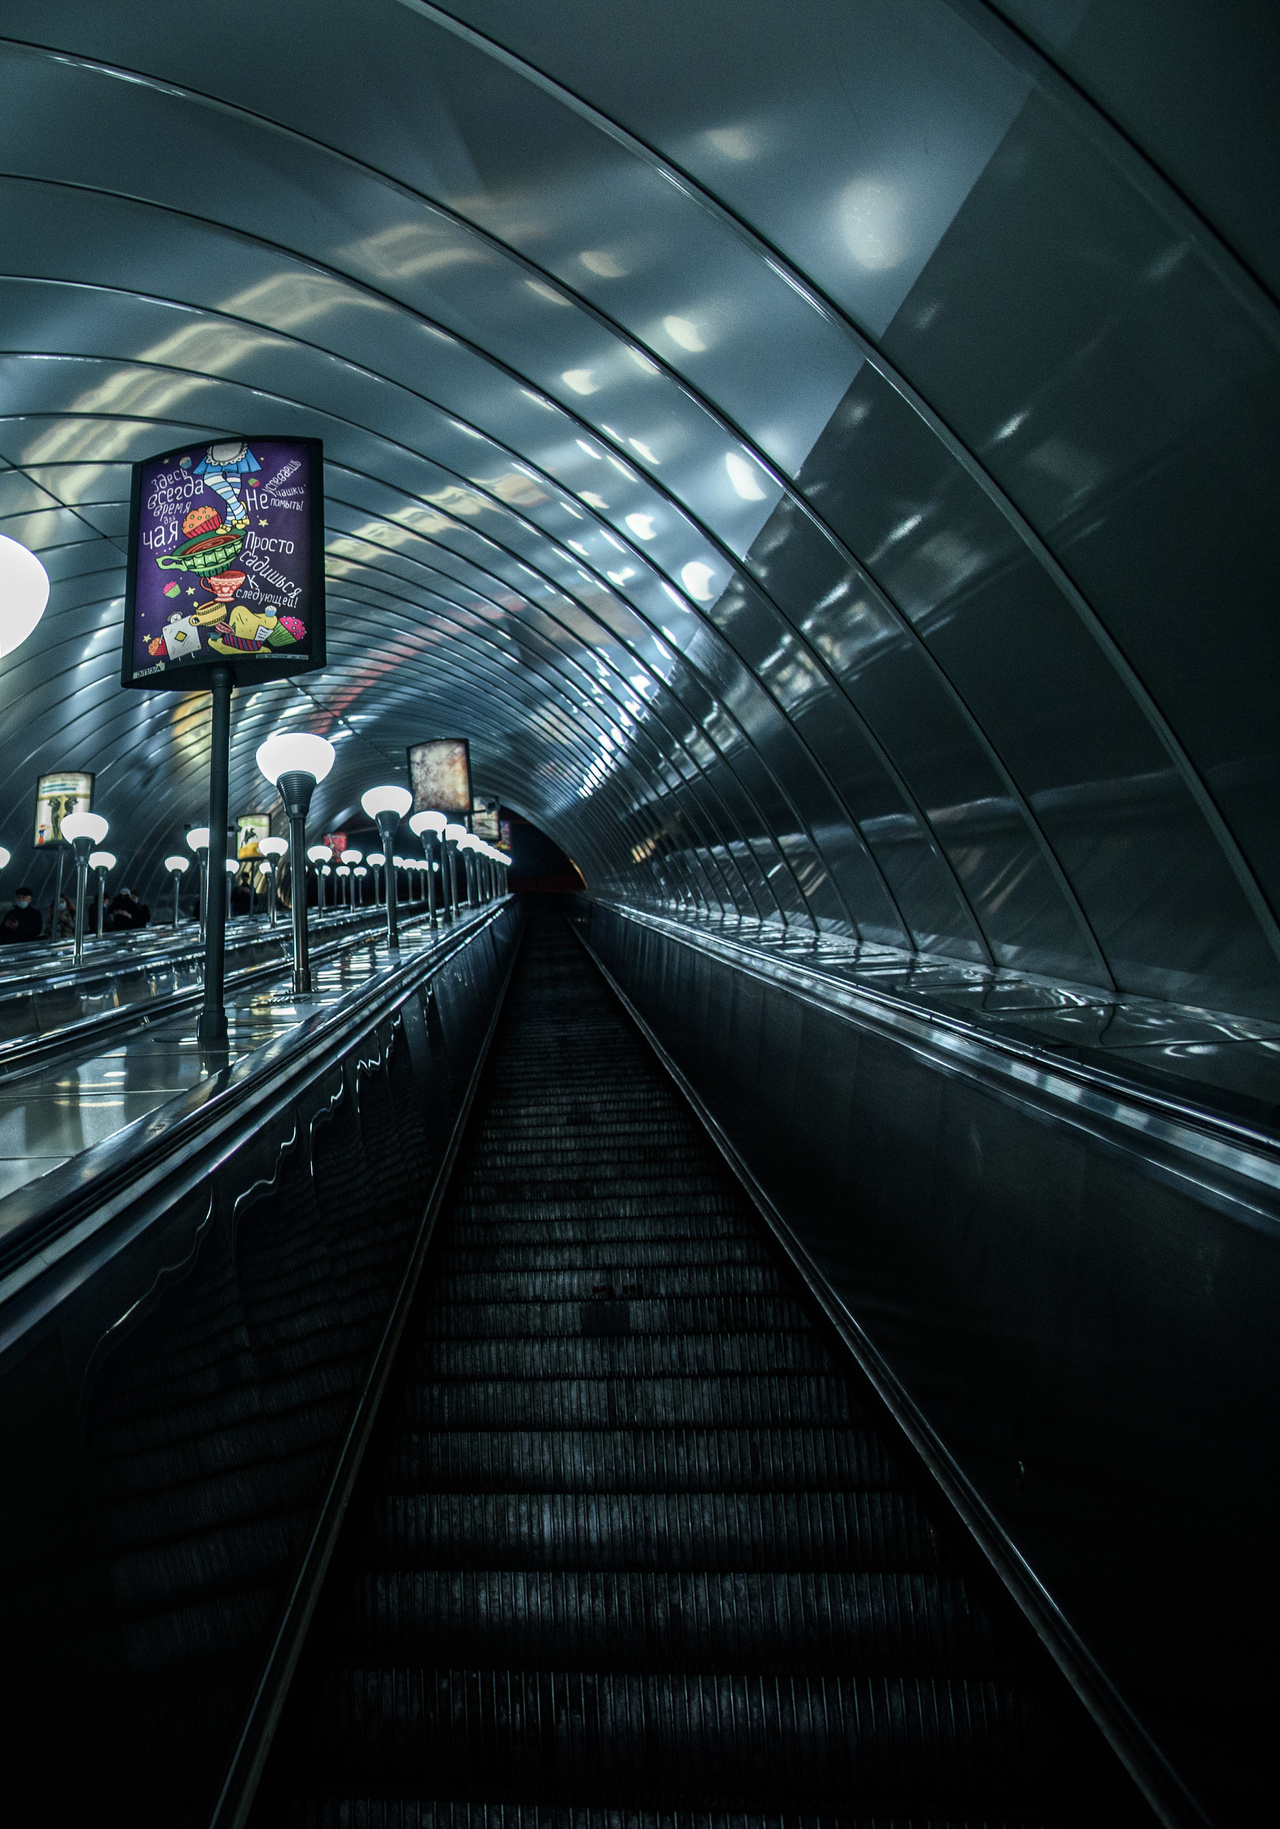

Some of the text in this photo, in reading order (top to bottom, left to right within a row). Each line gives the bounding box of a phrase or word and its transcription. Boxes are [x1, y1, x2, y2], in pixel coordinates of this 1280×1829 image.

[262, 460, 302, 498] успеваешь
[147, 476, 204, 510] всегда
[245, 489, 269, 512] Не
[270, 497, 304, 511] помыть!
[276, 486, 305, 498] чашки
[153, 501, 191, 522] время
[245, 531, 294, 556] Просто
[239, 550, 302, 598] садишься
